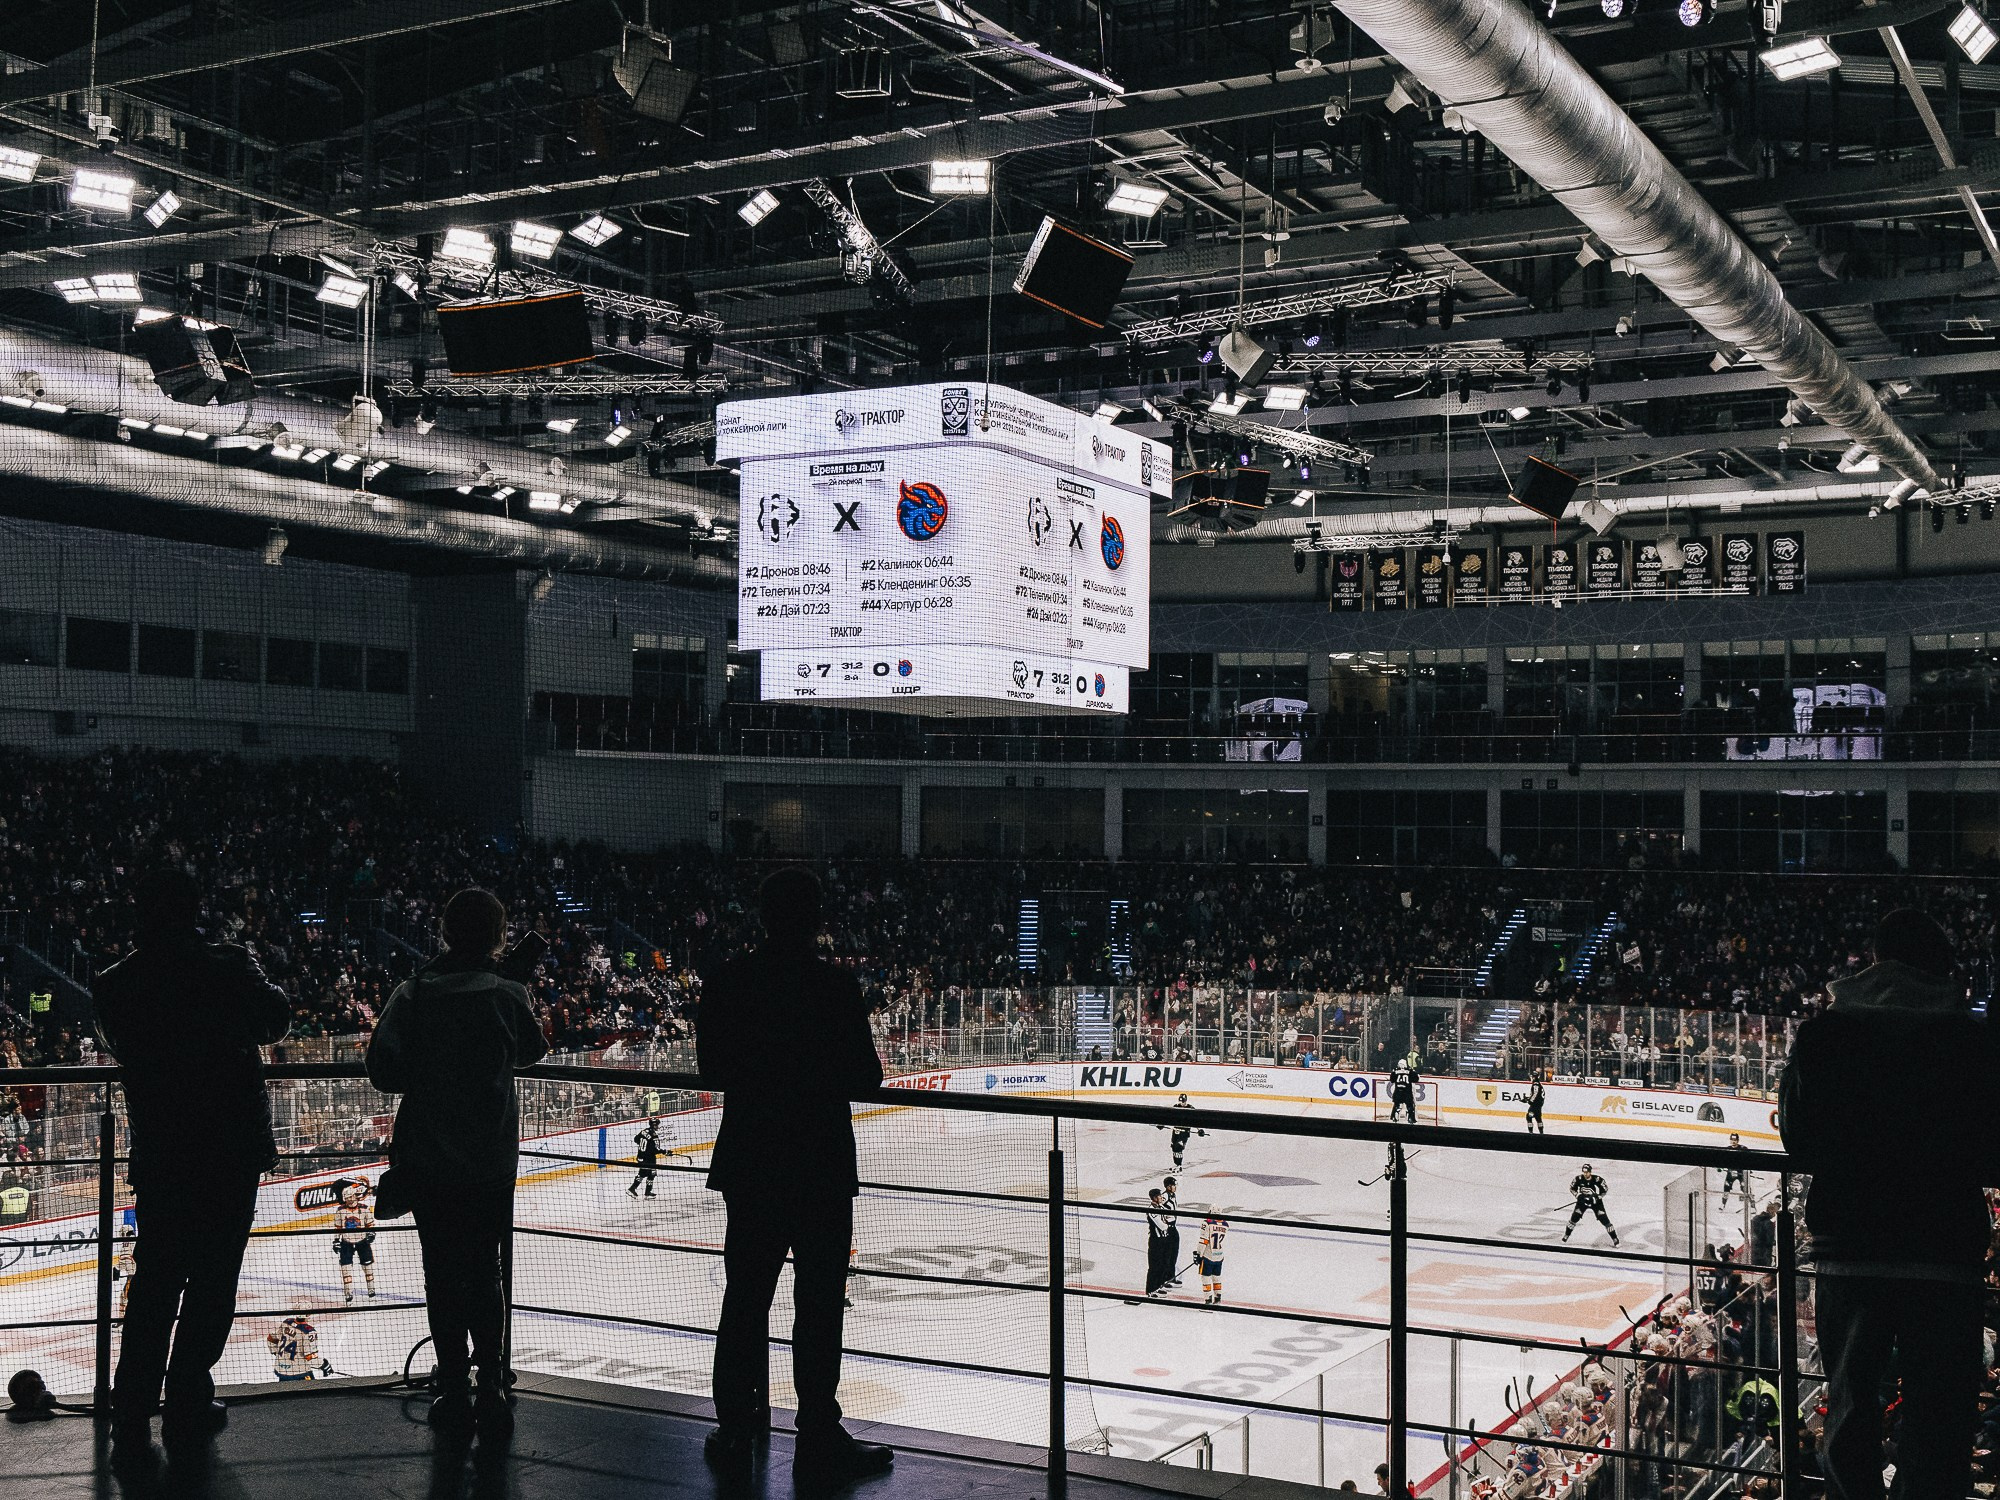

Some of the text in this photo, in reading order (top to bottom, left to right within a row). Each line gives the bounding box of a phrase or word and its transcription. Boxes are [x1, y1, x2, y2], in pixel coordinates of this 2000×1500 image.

[861, 409, 905, 425] ТРАКТОР
[974, 419, 1001, 428] СОН
[767, 423, 787, 432] ЛИГИ
[1104, 444, 1126, 462] ТРАКТОР
[812, 462, 883, 476] Время на льду
[838, 478, 862, 487] период
[861, 556, 954, 571] #2 Калинюк 06:44
[746, 563, 831, 582] #2 Дронов 08:46
[861, 575, 972, 591] #5 Кленденинг 06:35
[1778, 582, 1794, 591] 2025
[742, 583, 831, 598] #72 Телегин 07:34
[757, 603, 830, 619] #26 Дэй 07:23
[861, 597, 953, 613] #44 Харпур 06:28
[829, 627, 863, 638] ТРАКТОР
[816, 664, 832, 678] 7
[841, 662, 863, 670] 31.2
[872, 662, 890, 677] 0
[1034, 669, 1044, 688] 7
[1051, 672, 1070, 685] 31.2
[1076, 675, 1087, 694] 0
[793, 688, 817, 696] ТРК
[892, 686, 921, 695] ШДР
[1007, 690, 1035, 700] ТРАКТОР
[1086, 700, 1114, 710] ДРАКОНЫ
[1003, 1075, 1047, 1084] НОВАТЭК
[1080, 1066, 1183, 1088] KHL.RU
[1632, 1101, 1694, 1113] GISLAVED
